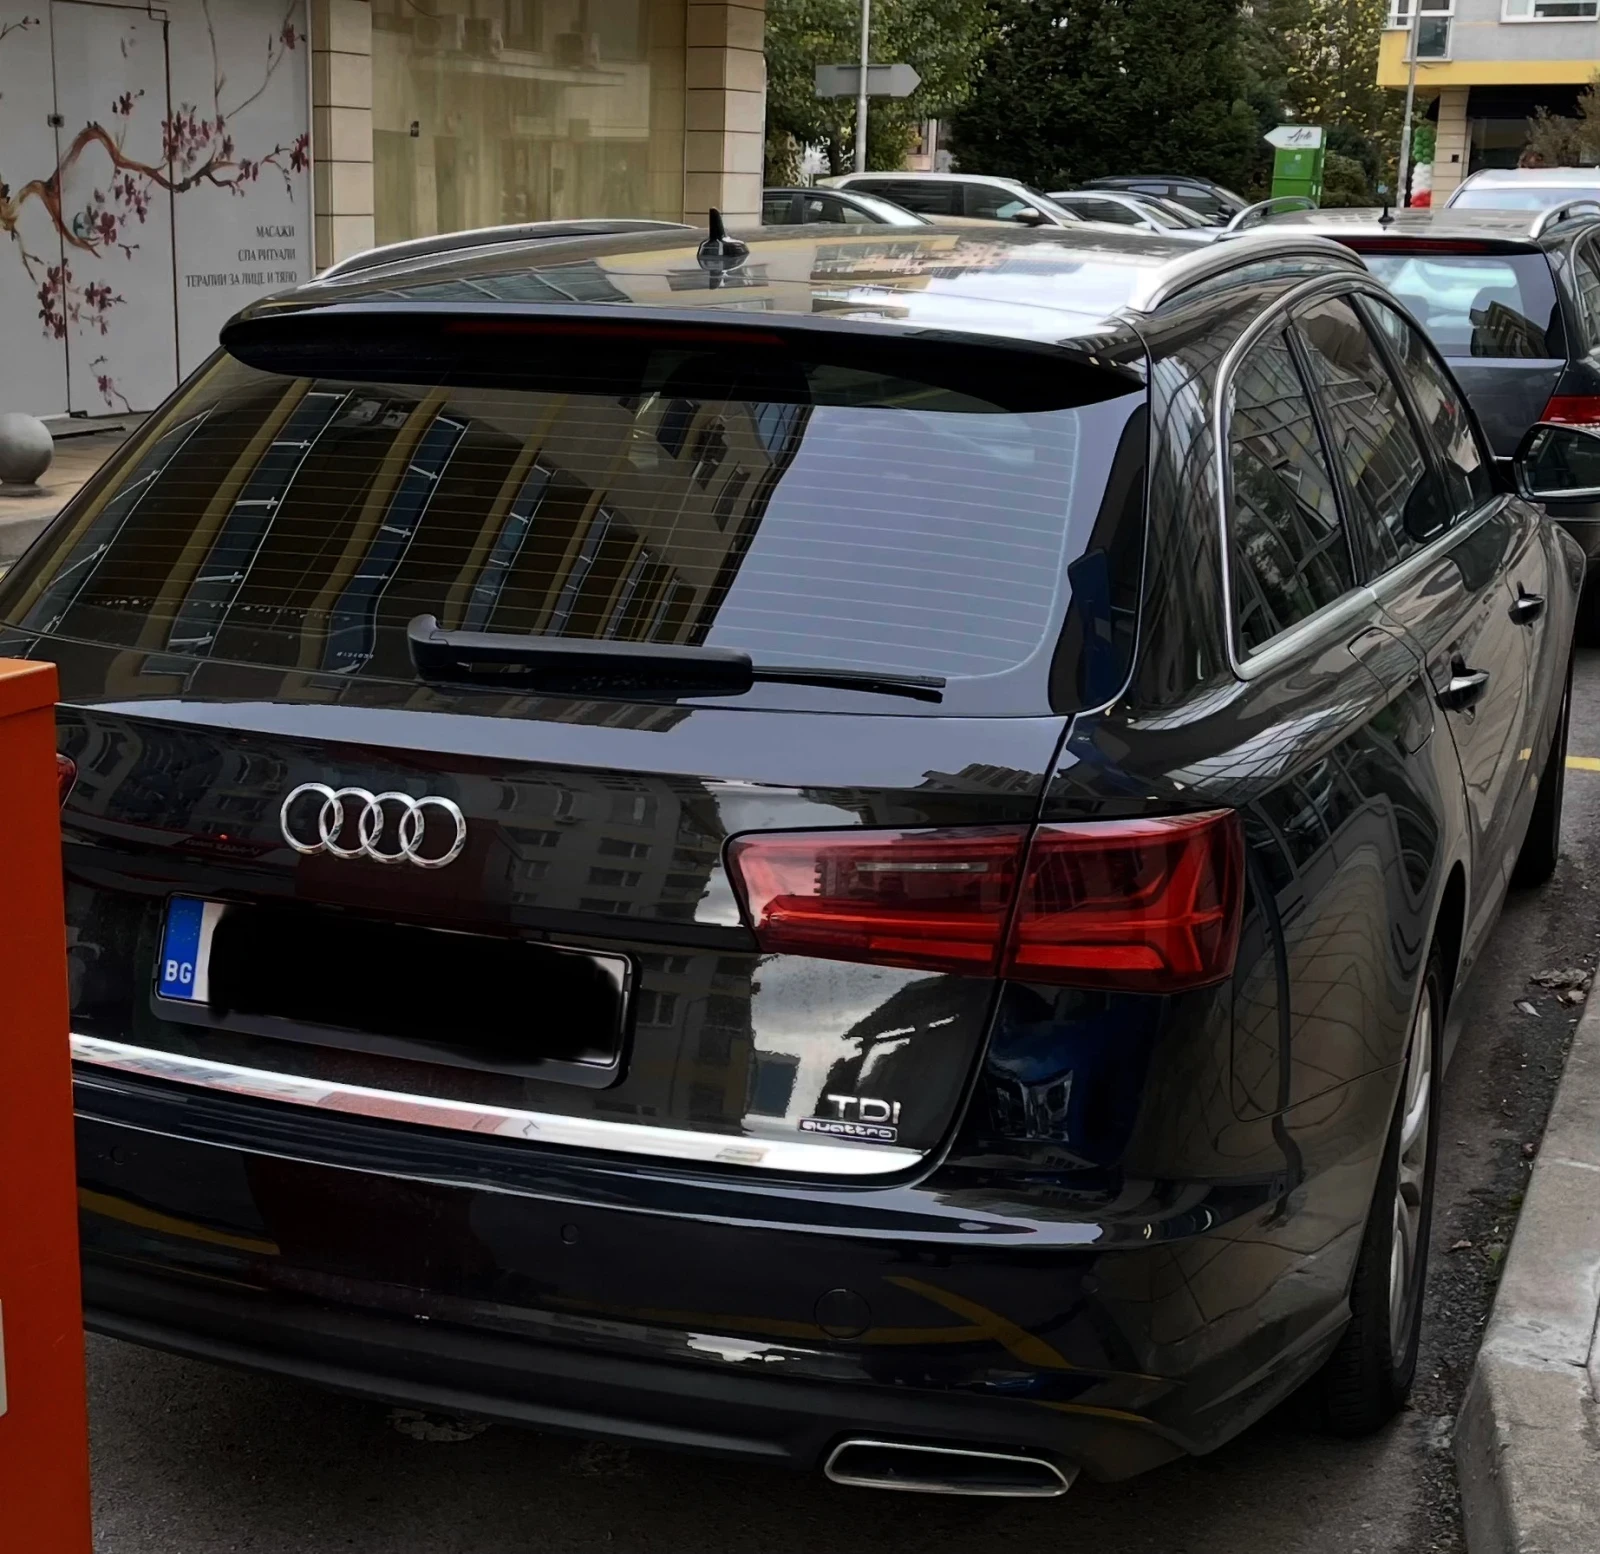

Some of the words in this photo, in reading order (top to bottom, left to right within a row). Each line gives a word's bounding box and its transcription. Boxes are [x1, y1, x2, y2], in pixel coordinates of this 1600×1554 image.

[256, 225, 295, 238] МАСАЖИ
[238, 248, 257, 262] СПА
[258, 248, 296, 261] РИТУАЛИ
[185, 273, 227, 287] ТЕРАПИИ
[228, 272, 240, 285] ЗА
[241, 271, 265, 286] ЛИЦЕ
[267, 271, 274, 283] И
[275, 271, 297, 283] ТЯЛО
[165, 959, 193, 984] BG
[827, 1094, 901, 1124] TDI
[802, 1120, 892, 1138] quattro
